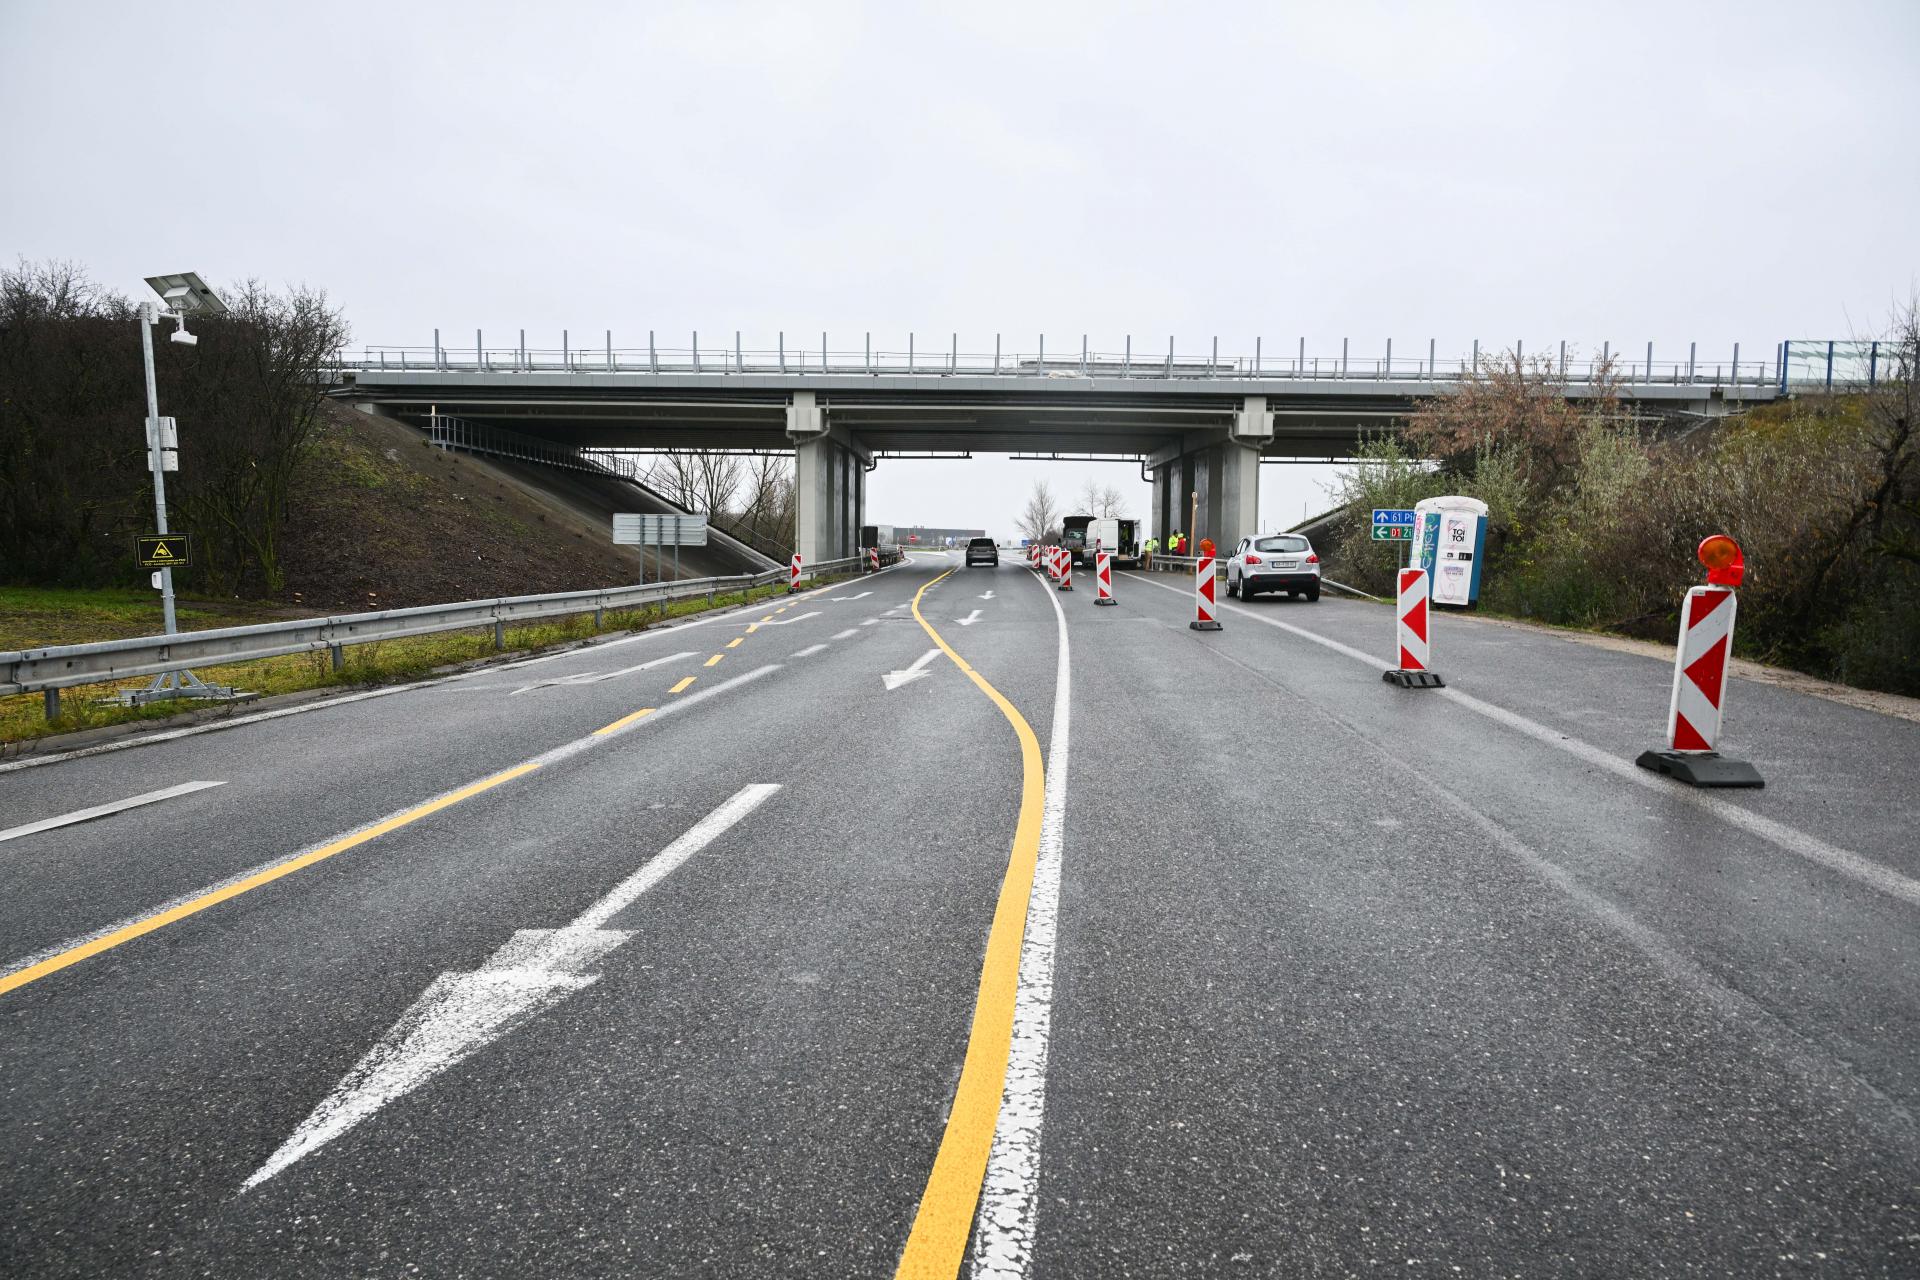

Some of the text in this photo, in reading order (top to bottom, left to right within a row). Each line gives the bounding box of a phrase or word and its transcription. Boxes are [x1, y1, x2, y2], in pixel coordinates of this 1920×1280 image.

[1392, 512, 1415, 522] 61 Pi
[1391, 527, 1412, 538] D1 Ži
